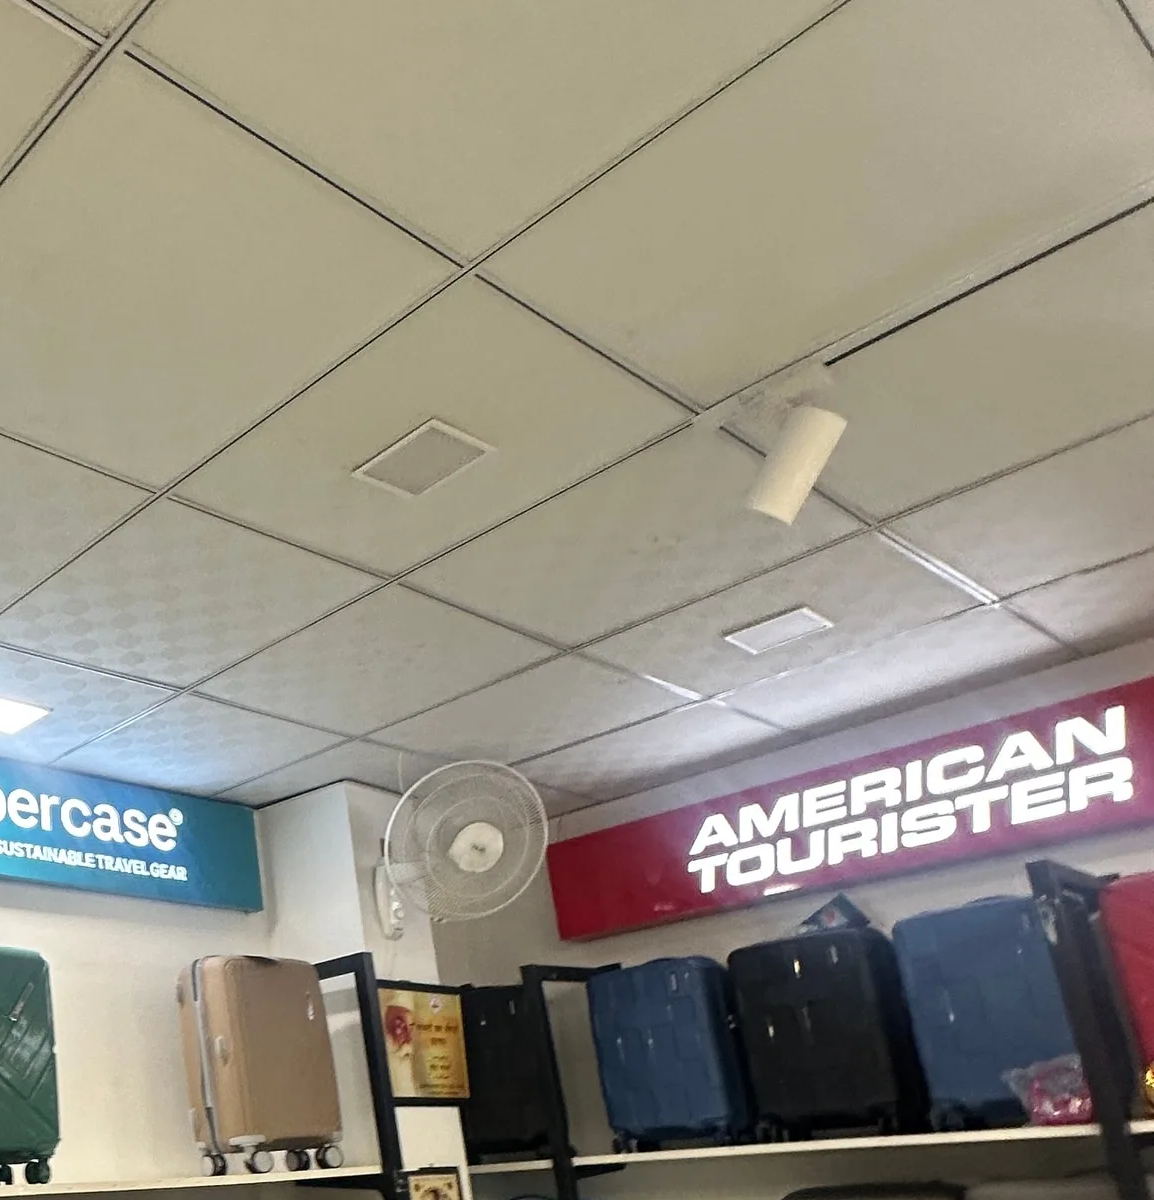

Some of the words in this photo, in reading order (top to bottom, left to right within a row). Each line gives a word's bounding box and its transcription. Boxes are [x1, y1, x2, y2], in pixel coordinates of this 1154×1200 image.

[687, 756, 1135, 894] TOURISTER
[688, 704, 1126, 856] AMERICAN
[94, 853, 151, 877] TRAVEL
[149, 862, 188, 882] GEAR
